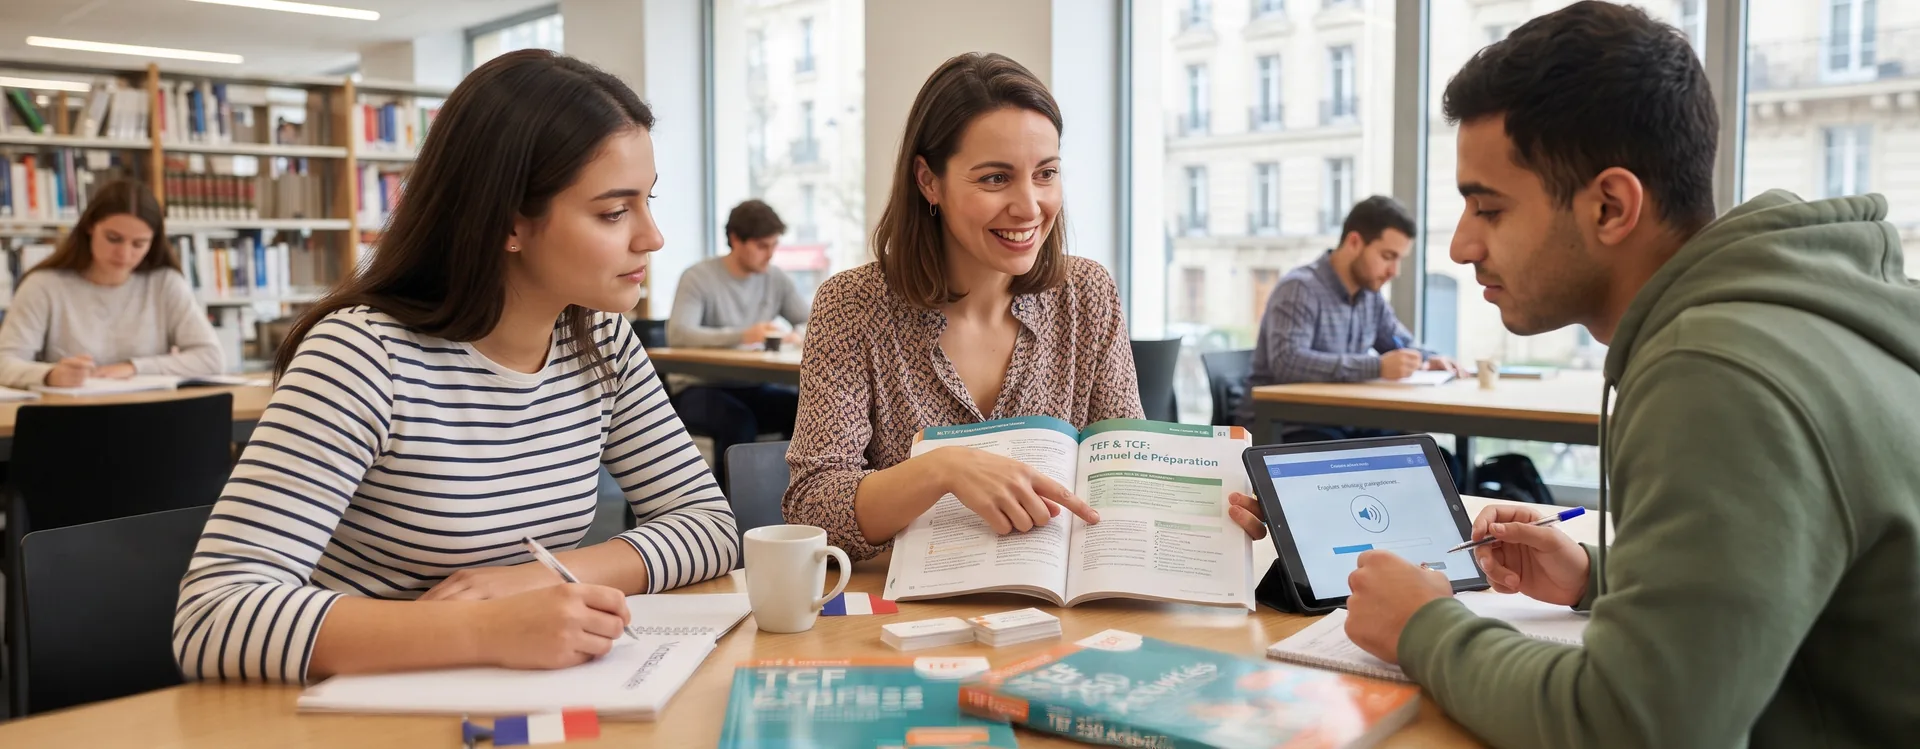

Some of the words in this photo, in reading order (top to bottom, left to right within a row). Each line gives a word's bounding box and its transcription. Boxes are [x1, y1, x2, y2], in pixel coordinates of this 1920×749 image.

[1090, 440, 1110, 451] TEF
[1112, 439, 1122, 449] &
[1125, 440, 1151, 450] TCF:
[1089, 451, 1131, 463] Manuel
[1133, 452, 1148, 461] de
[1151, 453, 1219, 467] Préparation
[757, 668, 847, 691] TCF
